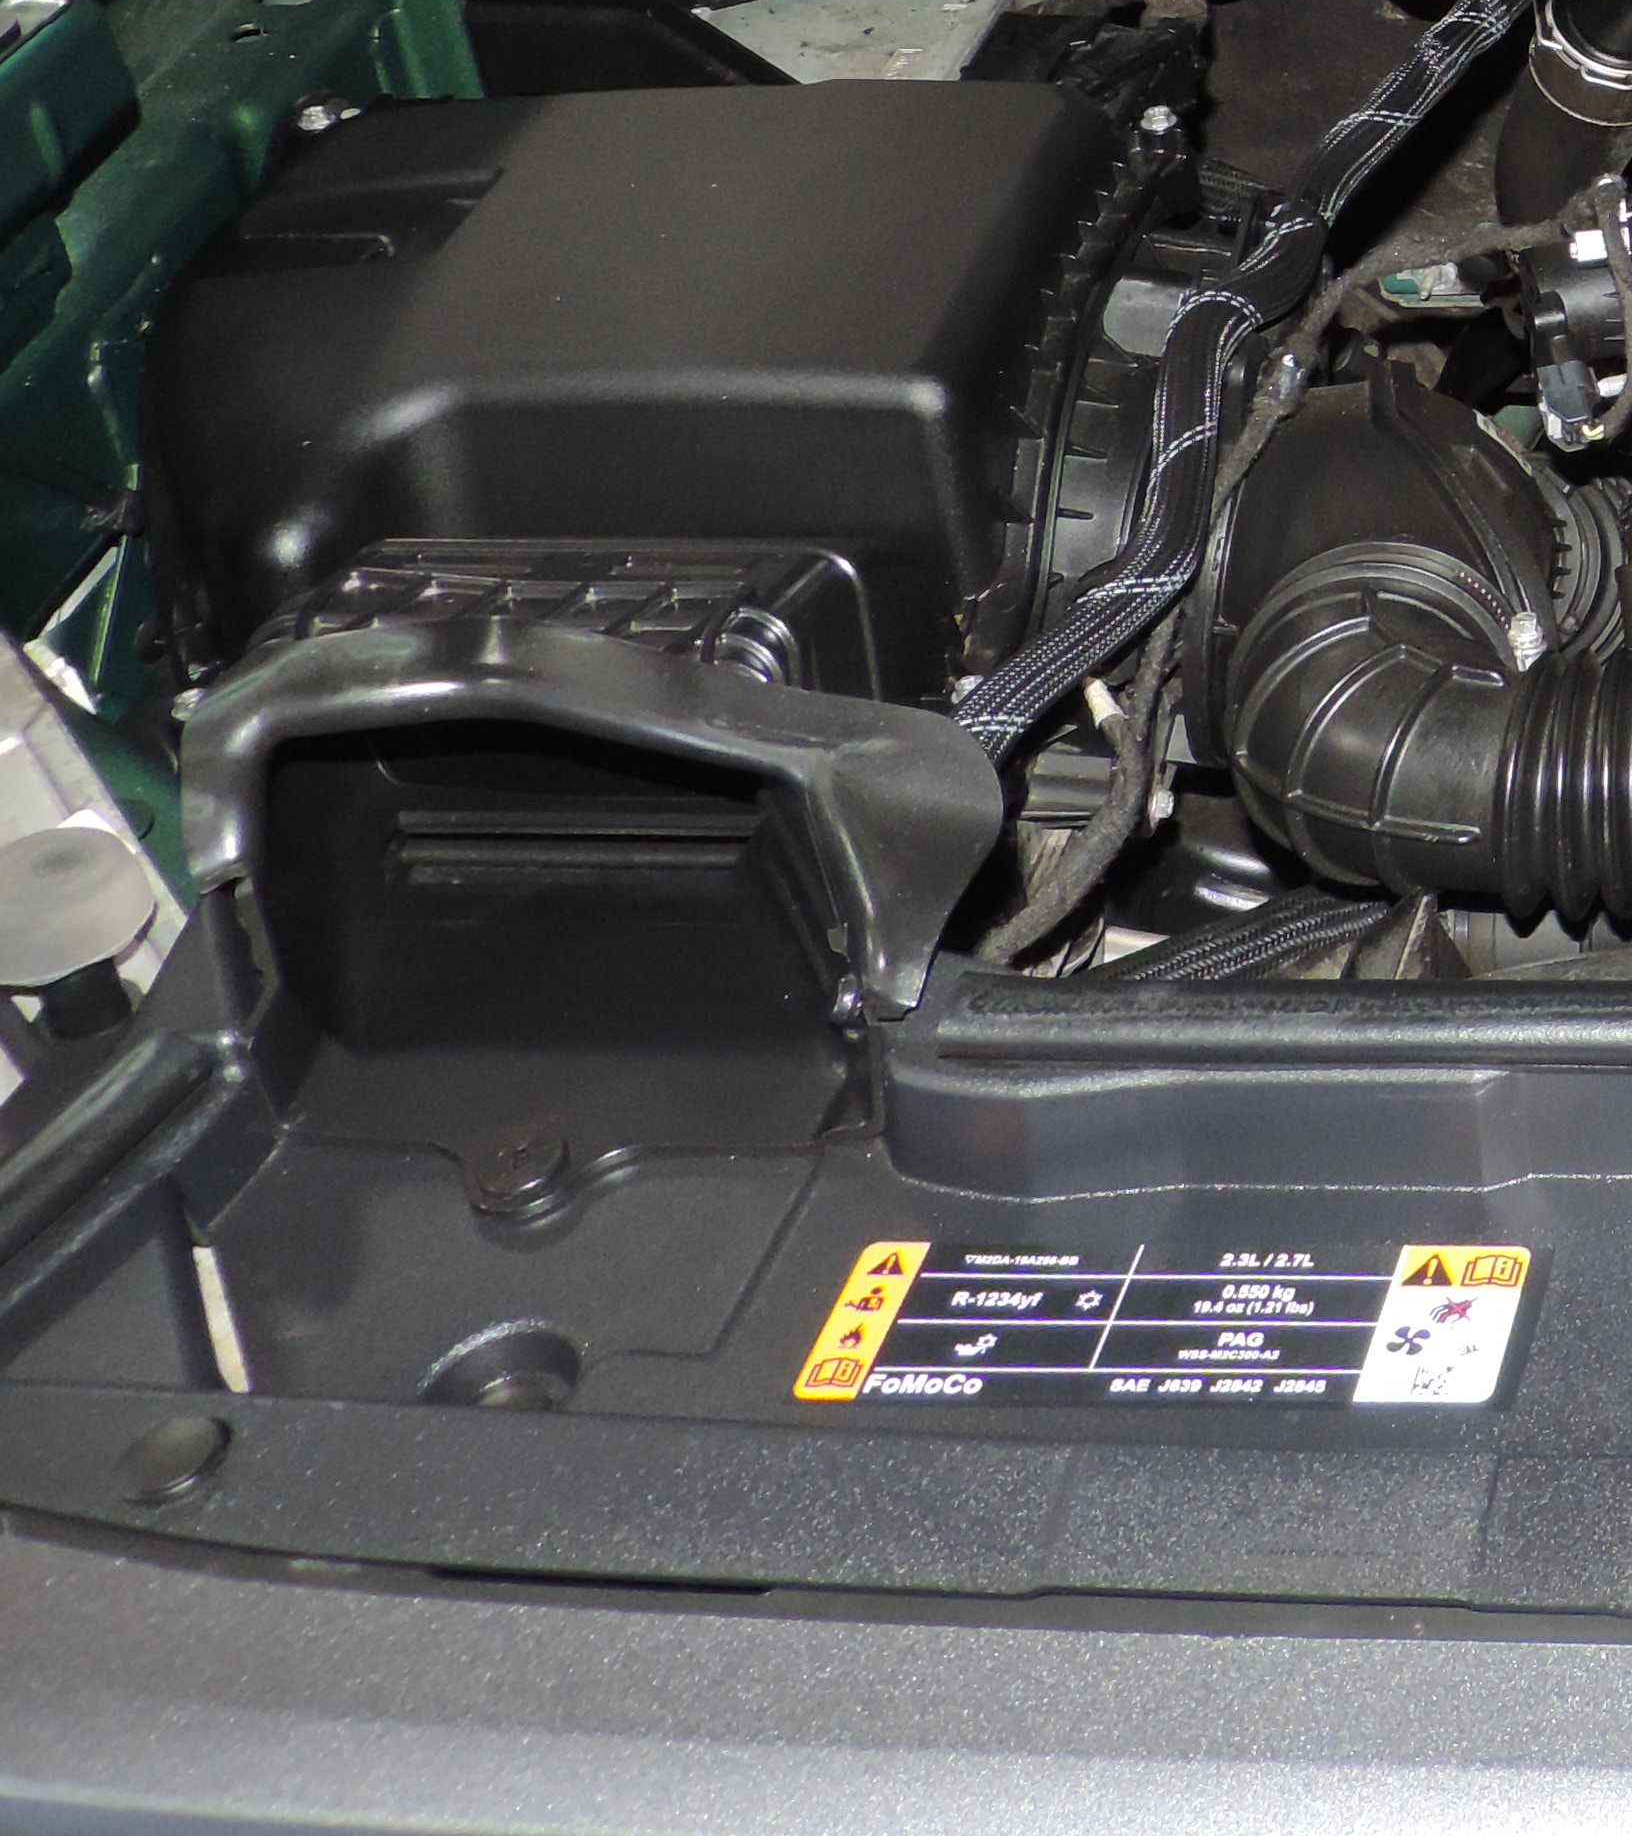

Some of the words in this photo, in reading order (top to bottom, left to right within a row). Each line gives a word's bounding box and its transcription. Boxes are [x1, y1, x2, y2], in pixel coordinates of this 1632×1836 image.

[1219, 1253, 1261, 1268] 2.3L
[1262, 1253, 1274, 1268] /
[1273, 1253, 1315, 1268] 2.7L
[950, 1291, 1045, 1311] R-1234yf
[1222, 1284, 1270, 1300] 0.550
[1272, 1284, 1297, 1302] kg
[1192, 1300, 1225, 1314] 19.4
[1225, 1303, 1245, 1314] oz
[1246, 1300, 1283, 1317] (1.21
[1284, 1301, 1315, 1317] lbs)
[1216, 1332, 1265, 1347] PAG
[862, 1374, 984, 1395] FoMoCo
[1109, 1378, 1152, 1393] SAE
[1157, 1378, 1204, 1393] J639
